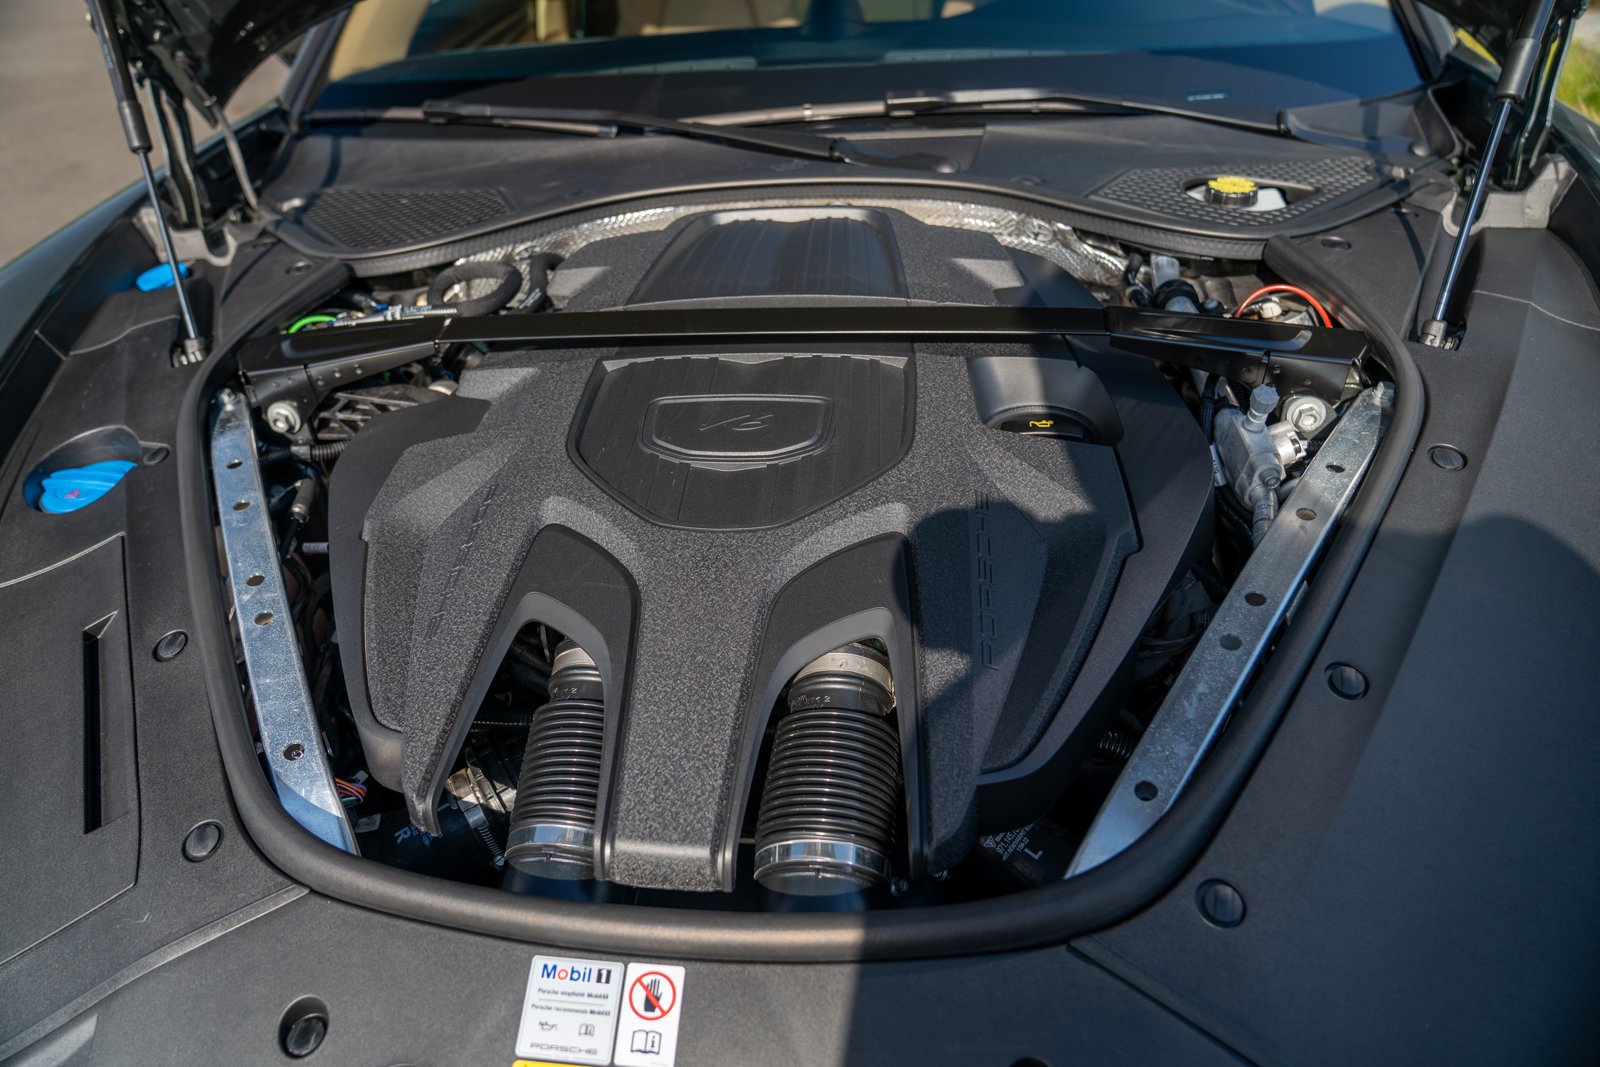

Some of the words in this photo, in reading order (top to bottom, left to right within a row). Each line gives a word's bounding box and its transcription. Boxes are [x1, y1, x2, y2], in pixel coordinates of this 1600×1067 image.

[394, 826, 411, 844] R
[1024, 847, 1043, 860] L
[541, 963, 592, 982] Mobil
[530, 1042, 598, 1055] PORSCHE
